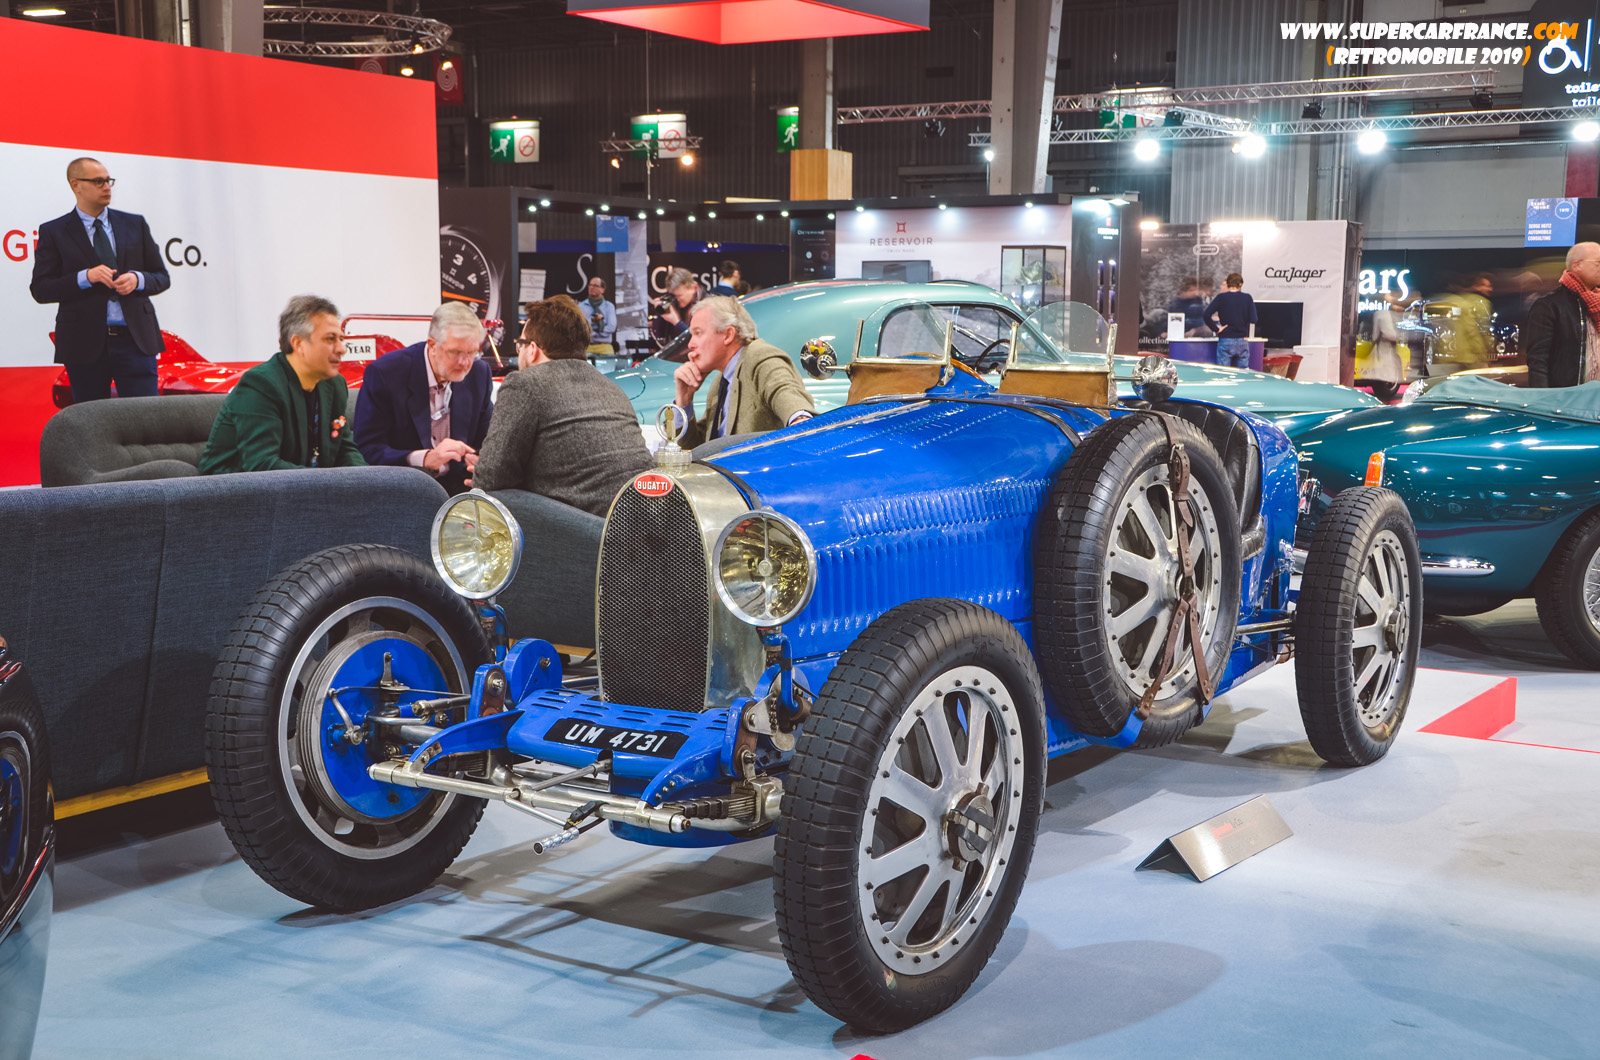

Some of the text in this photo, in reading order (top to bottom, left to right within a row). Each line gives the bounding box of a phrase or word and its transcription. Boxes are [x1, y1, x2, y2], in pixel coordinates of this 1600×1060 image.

[1565, 82, 1600, 94] toile
[870, 237, 933, 246] RESERVOIR
[165, 237, 207, 267] Co.
[1264, 267, 1326, 283] CarJager
[1358, 269, 1410, 301] ars
[1138, 336, 1170, 345] ollection
[637, 481, 668, 491] BUGATTI
[564, 723, 668, 753] UM 4731
